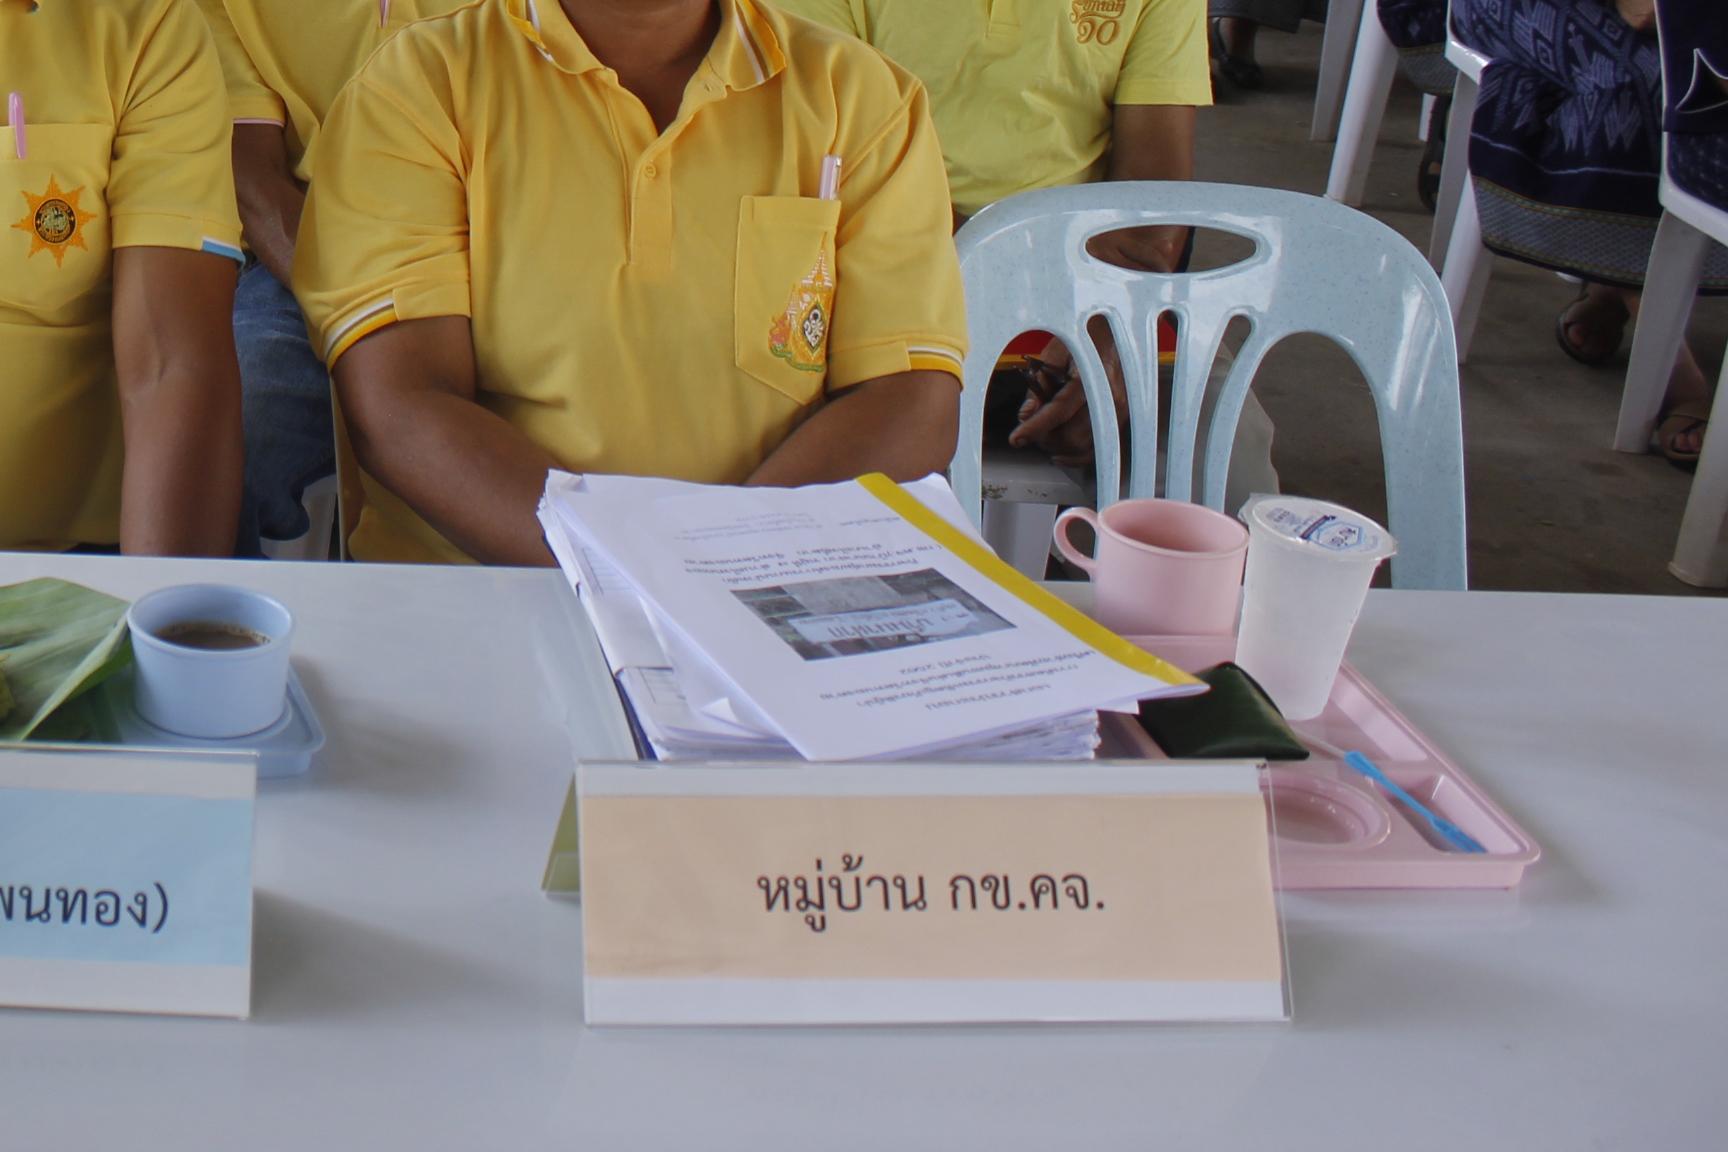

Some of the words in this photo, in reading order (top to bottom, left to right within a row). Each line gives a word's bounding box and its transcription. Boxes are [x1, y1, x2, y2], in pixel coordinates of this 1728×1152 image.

[757, 853, 928, 933] หมู่บ้าน
[948, 872, 1106, 913] กข.คจ.
